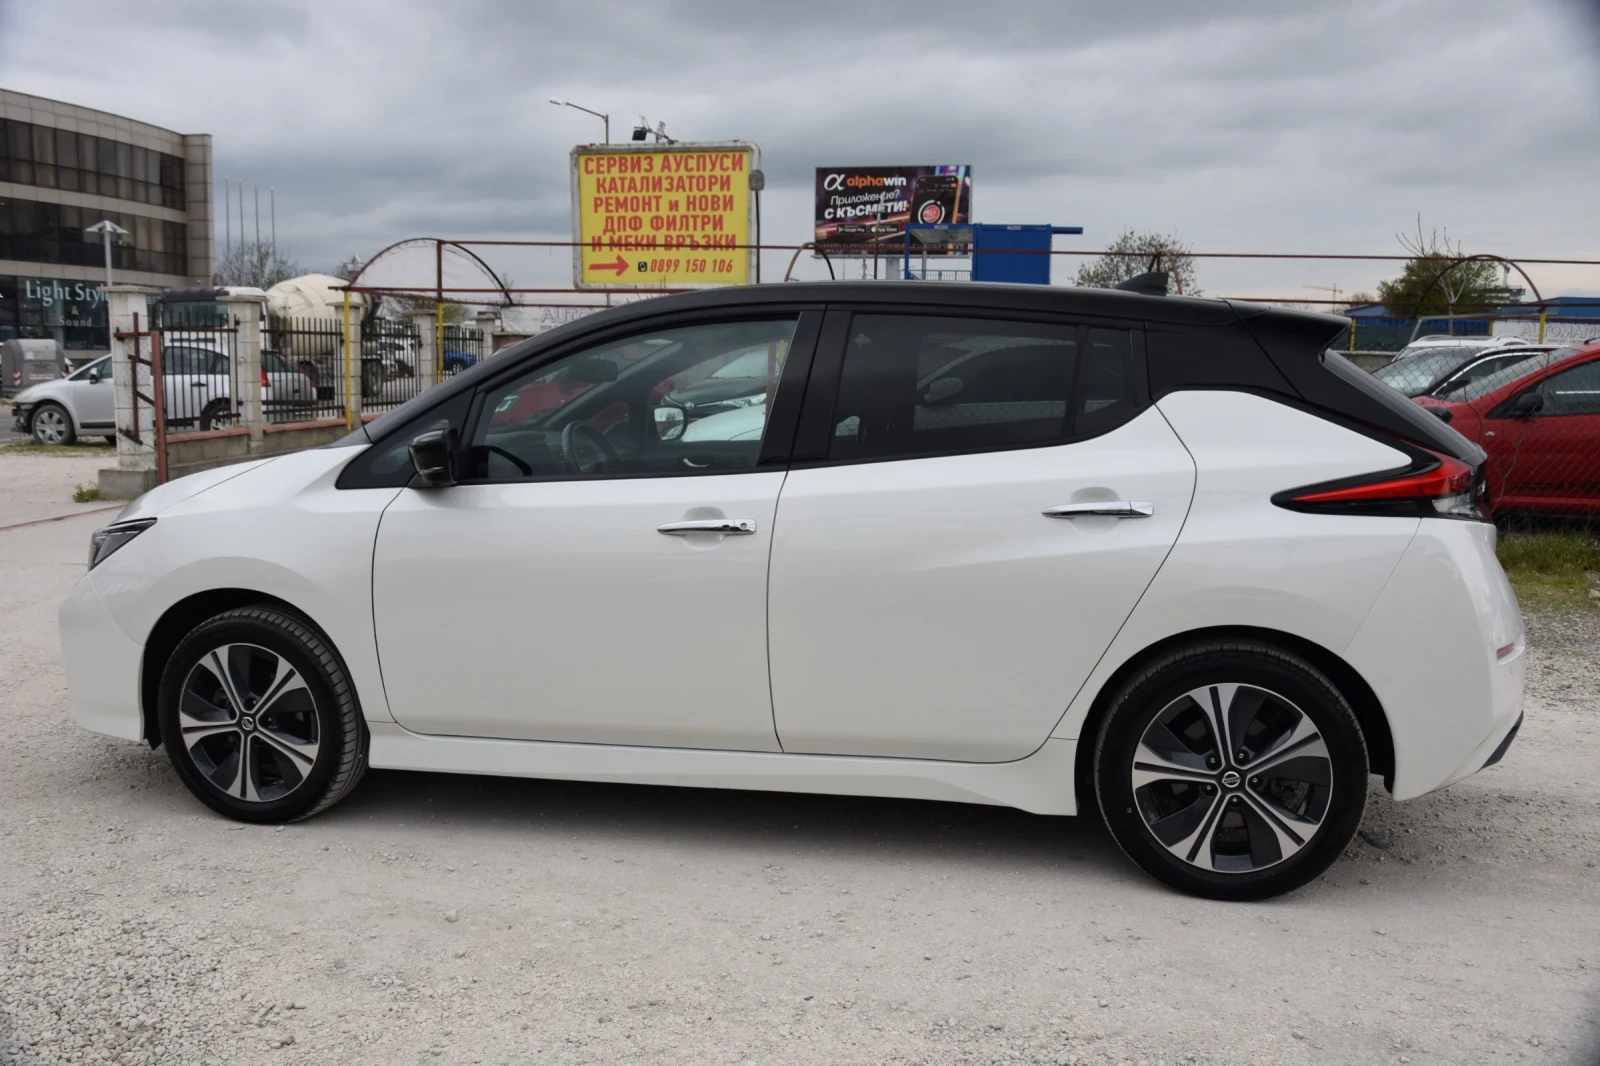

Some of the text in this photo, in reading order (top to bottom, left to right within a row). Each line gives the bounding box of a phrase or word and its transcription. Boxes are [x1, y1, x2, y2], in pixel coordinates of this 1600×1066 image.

[584, 154, 743, 175] СЕРВИЗ АУСПУСИ
[596, 175, 731, 194] КАТАЛИЗАТОРИ
[846, 174, 906, 189] alphawin
[593, 195, 662, 214] РЕМОНТ
[686, 195, 734, 212] НОВИ
[830, 189, 900, 206] Приложение?
[836, 200, 908, 218] КЪСМЕТИ!
[603, 214, 724, 235] ДПФ ФИЛТРИ
[591, 234, 736, 252] И МЕКИ ВРЪЗКИ
[650, 258, 734, 273] 0899 150 106
[26, 280, 71, 307] Light
[71, 305, 79, 315] &
[59, 316, 93, 327] Sound
